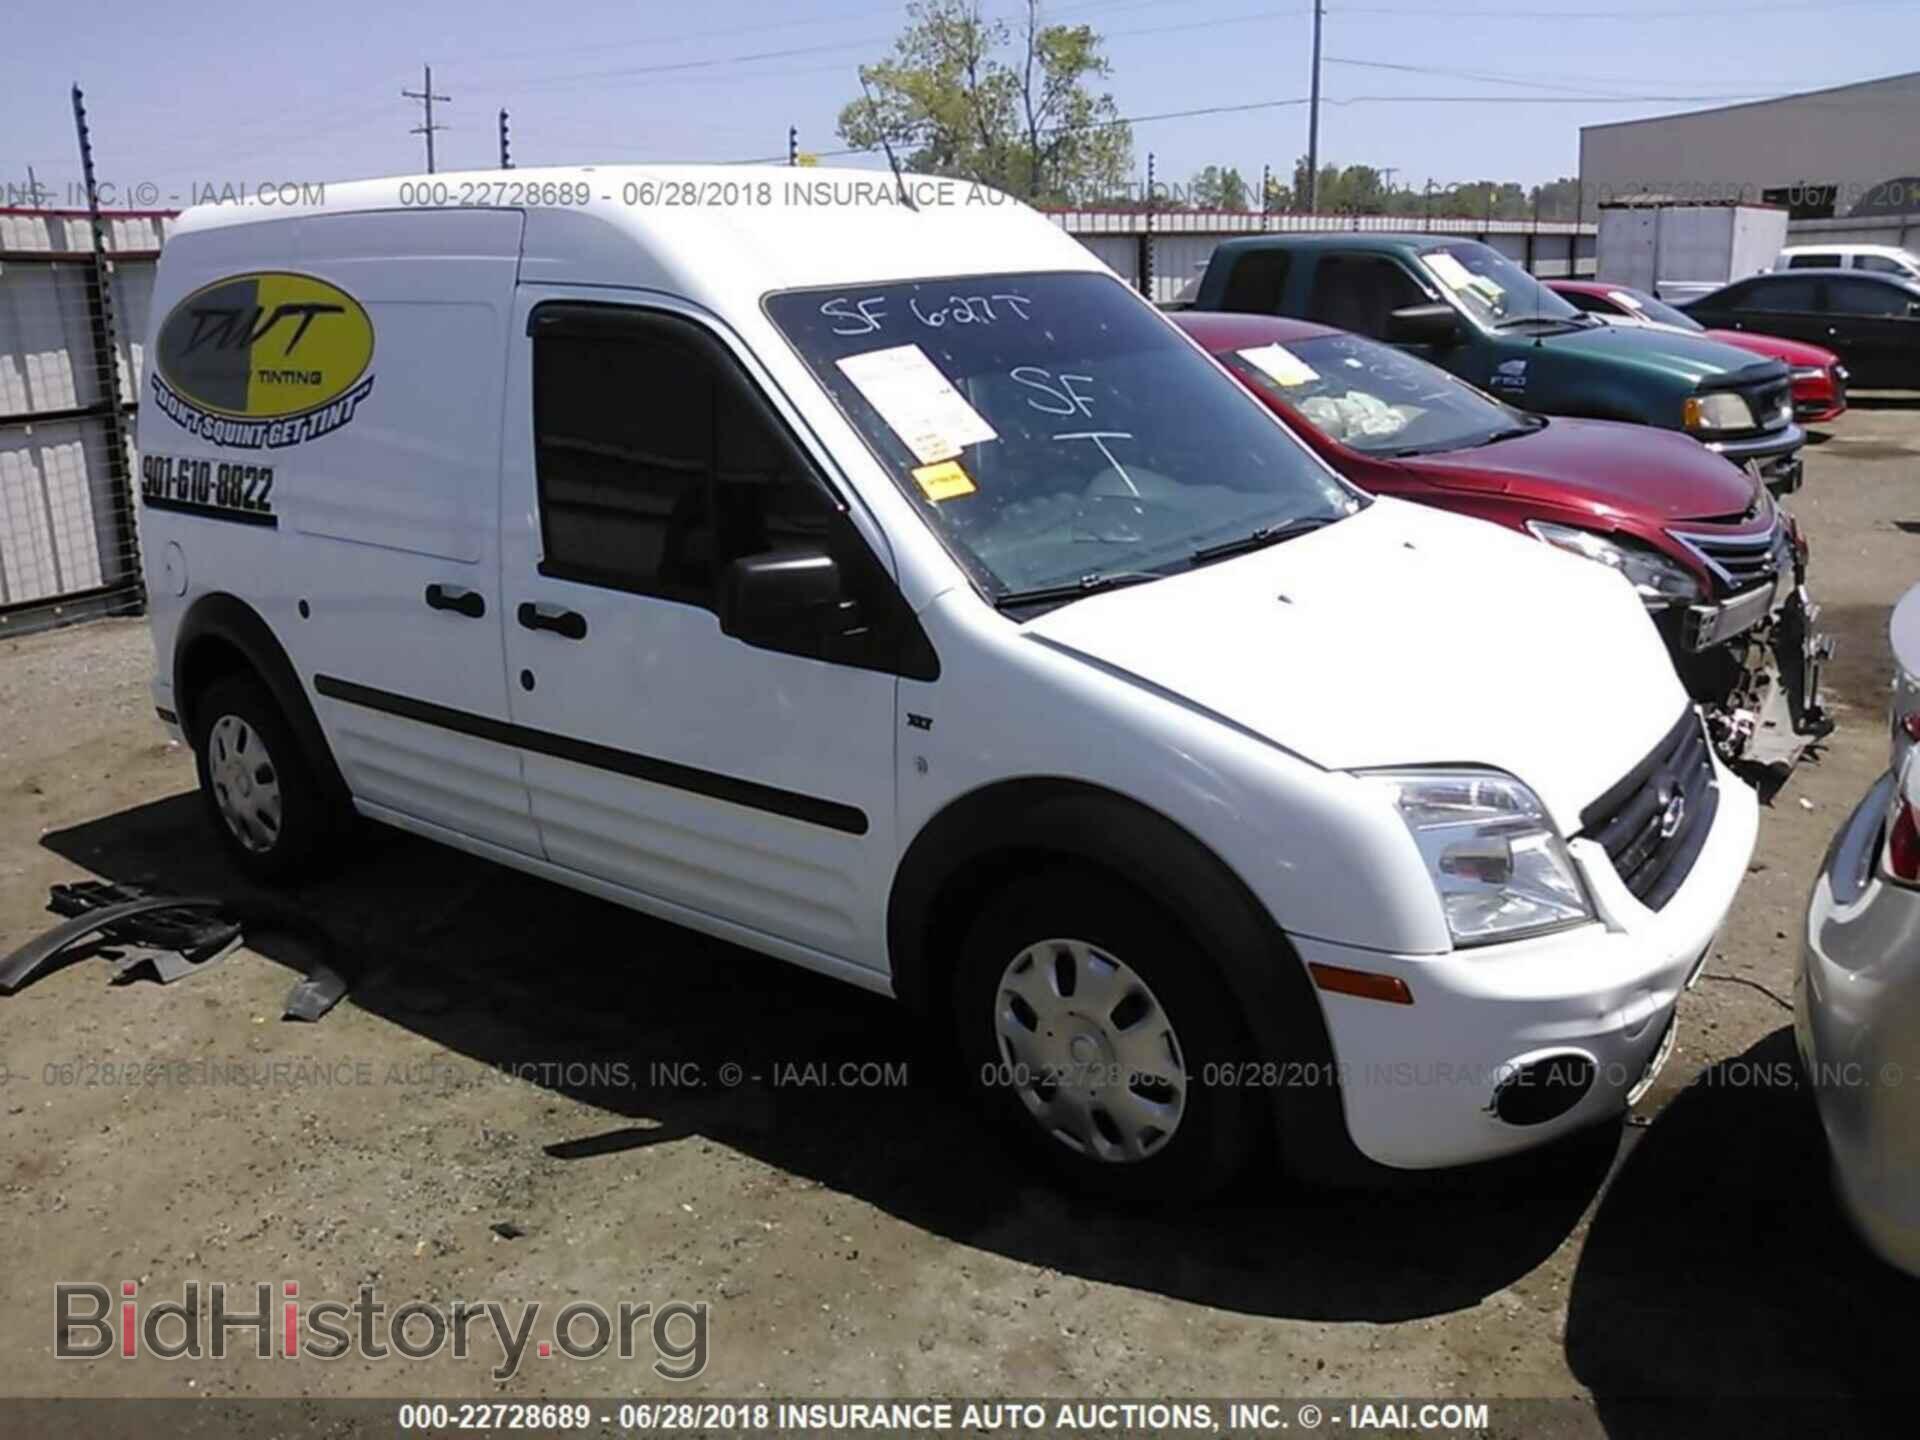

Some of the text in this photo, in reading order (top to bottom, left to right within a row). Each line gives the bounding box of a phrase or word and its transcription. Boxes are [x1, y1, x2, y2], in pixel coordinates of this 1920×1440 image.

[258, 369, 322, 386] TINTING
[1010, 366, 1096, 418] SF
[201, 418, 267, 449] SQUINT
[266, 417, 306, 449] GET
[142, 454, 274, 512] 901-610-8822
